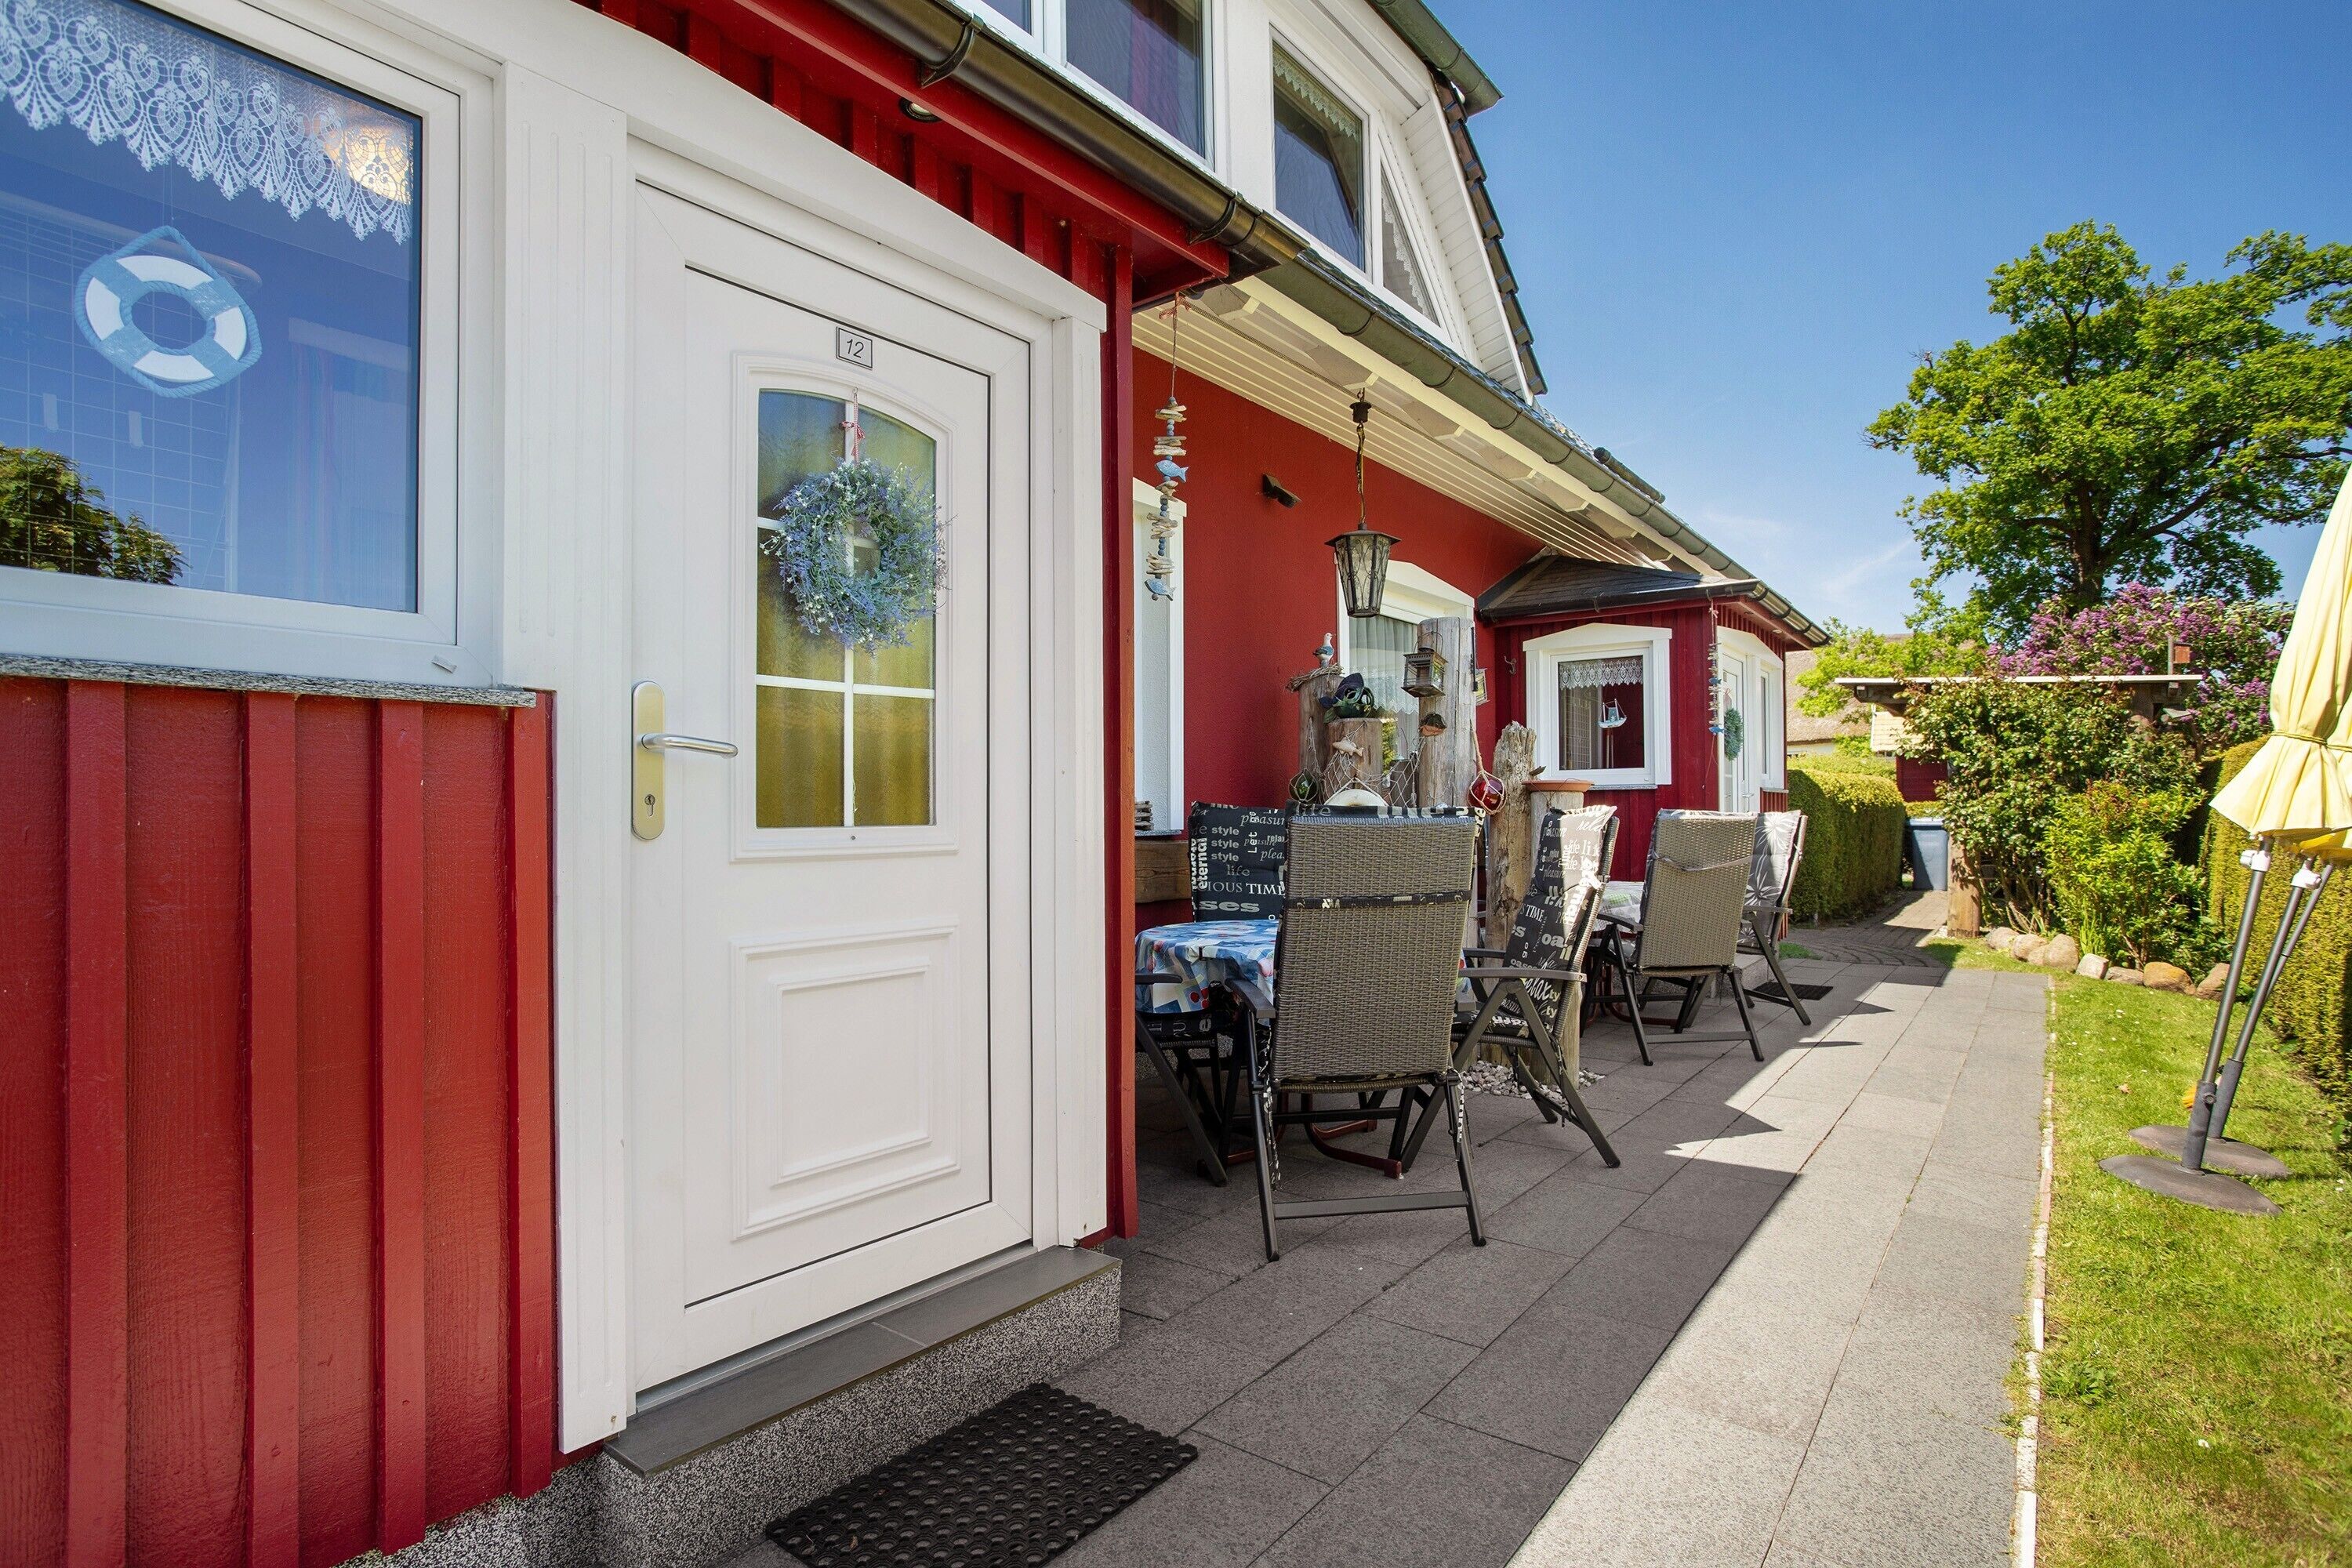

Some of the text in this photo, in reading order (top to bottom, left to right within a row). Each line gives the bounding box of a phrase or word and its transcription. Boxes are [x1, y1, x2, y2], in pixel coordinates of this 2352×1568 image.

[847, 339, 864, 358] 12
[1211, 826, 1240, 837] style
[1211, 839, 1240, 850] style
[1247, 831, 1258, 853] Let
[1211, 851, 1240, 862] style
[1260, 848, 1285, 862] plea
[1196, 837, 1208, 891] eternal
[1226, 864, 1250, 877] life
[1524, 977, 1552, 1001] elax
